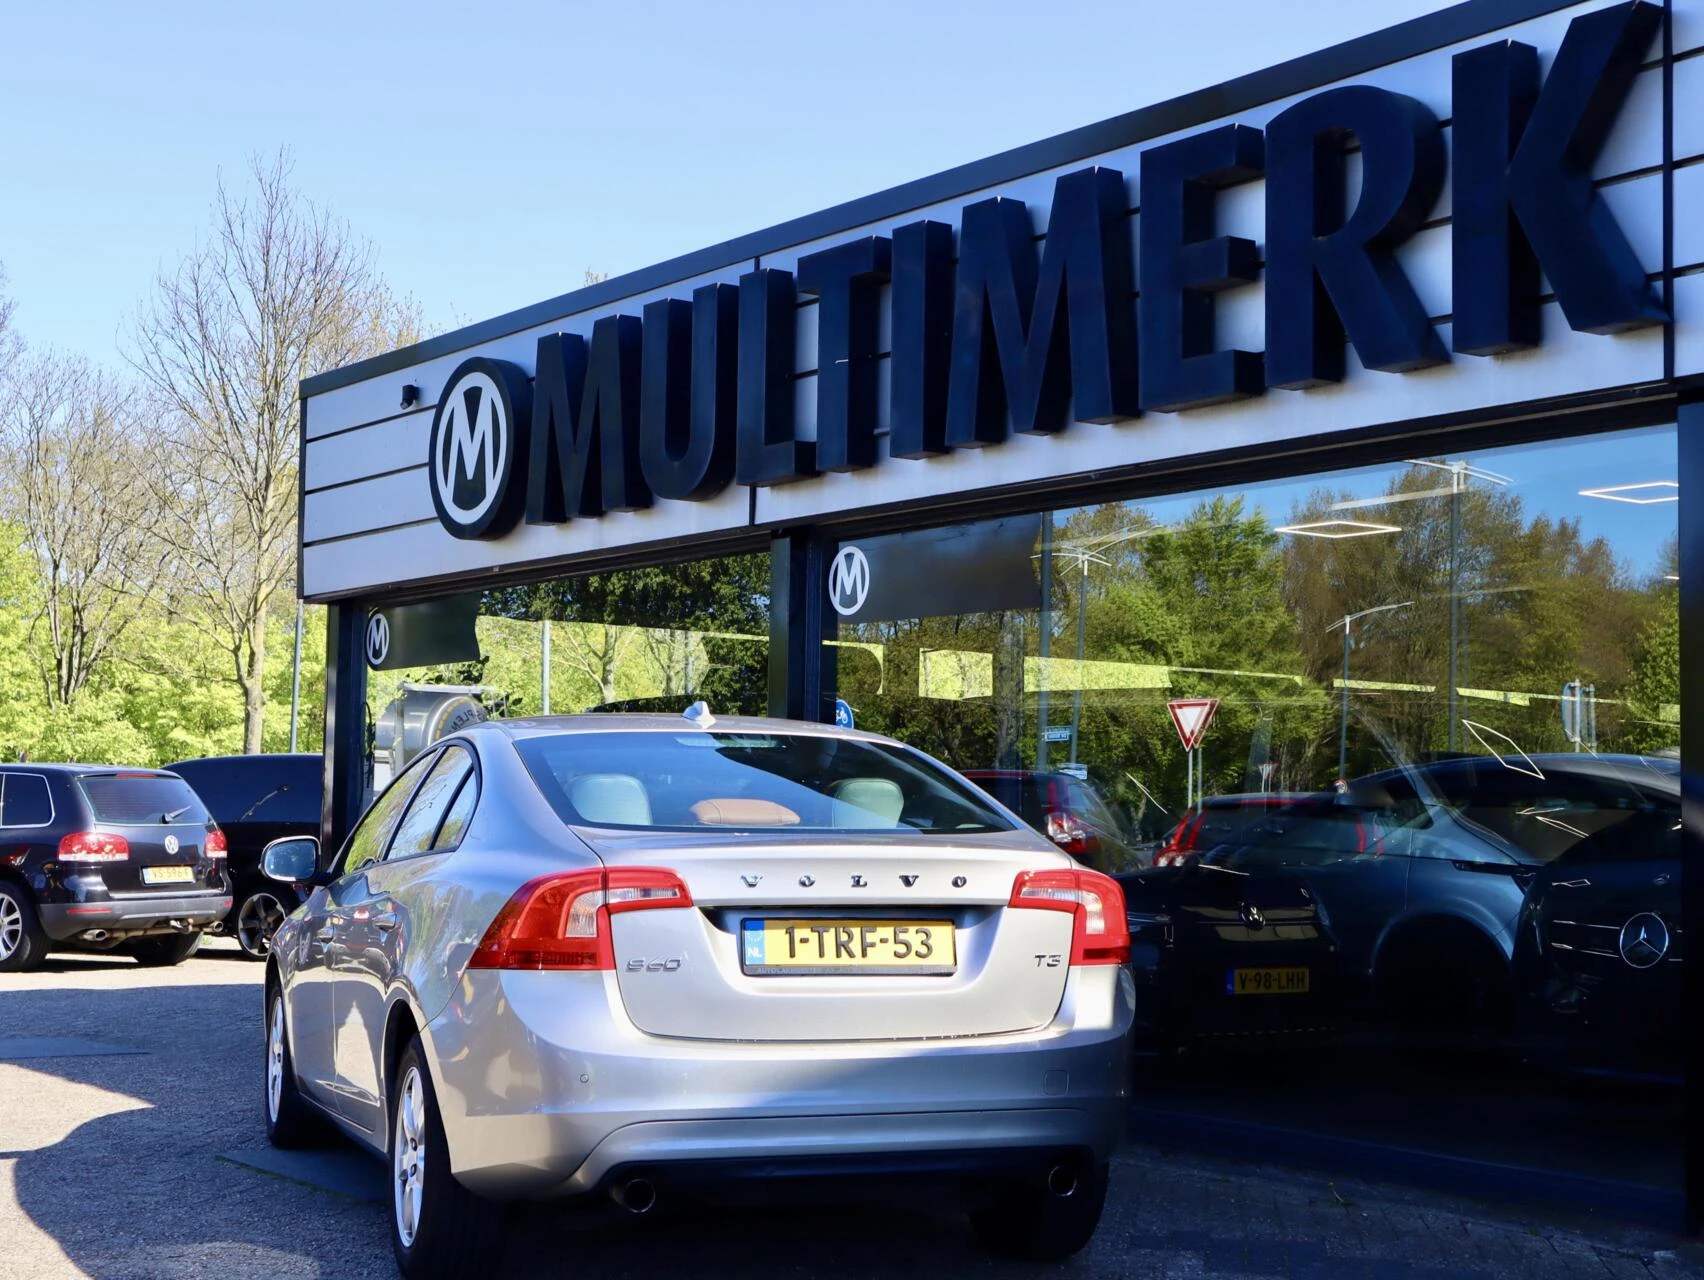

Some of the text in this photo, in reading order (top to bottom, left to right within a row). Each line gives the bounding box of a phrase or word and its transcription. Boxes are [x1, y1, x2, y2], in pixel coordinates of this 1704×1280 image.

[526, 0, 1670, 525] MULTIMERK
[740, 874, 968, 889] VOLVO
[784, 926, 934, 959] 1-TRF-53
[747, 947, 762, 958] NL
[626, 957, 682, 972] S60
[1239, 971, 1306, 990] V-98-LHH
